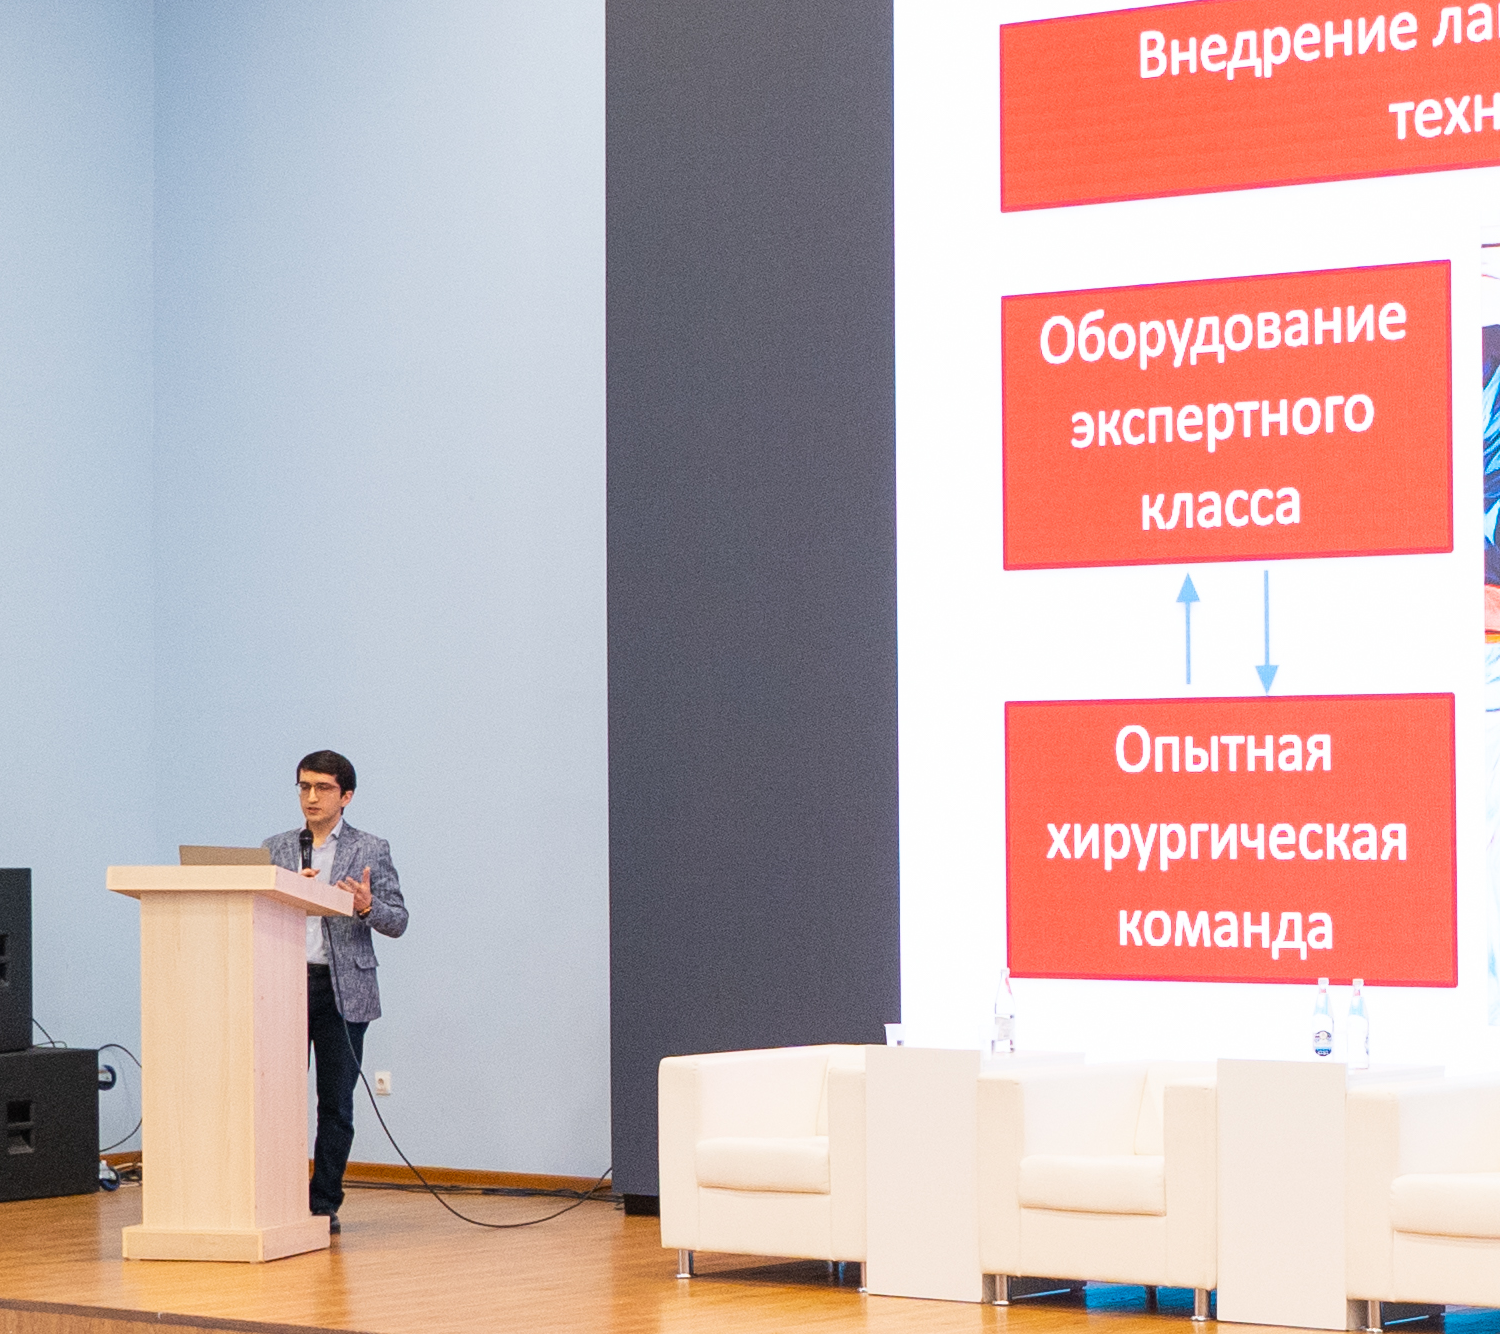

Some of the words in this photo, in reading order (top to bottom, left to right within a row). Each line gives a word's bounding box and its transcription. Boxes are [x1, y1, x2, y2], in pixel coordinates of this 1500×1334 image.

[1139, 11, 1419, 81] Внедрение
[1039, 301, 1407, 371] Оборудование
[1070, 393, 1375, 454] экспертного
[1141, 486, 1301, 531] класса
[1115, 724, 1332, 773] Опытная
[1046, 821, 1408, 873] хирургическая
[1118, 909, 1334, 961] команда
